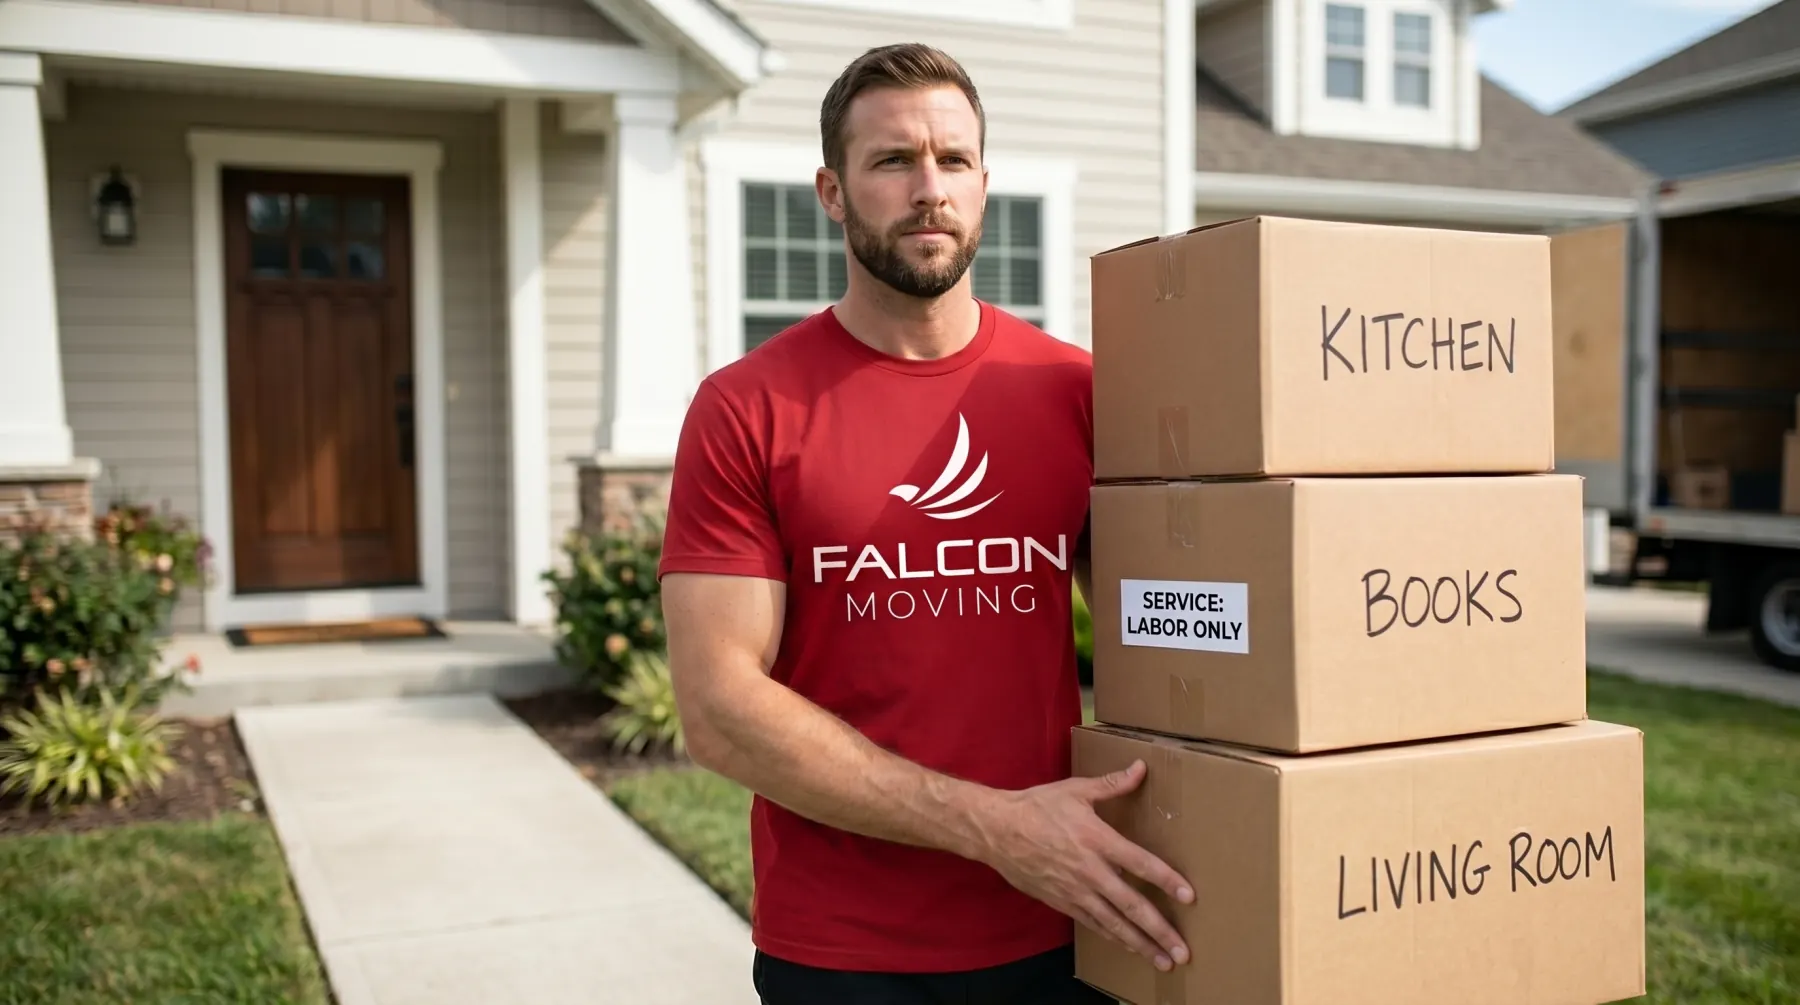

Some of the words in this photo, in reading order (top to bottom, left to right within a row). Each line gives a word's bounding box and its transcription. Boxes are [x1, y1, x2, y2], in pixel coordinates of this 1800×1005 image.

[1320, 304, 1517, 382] KITCHEN
[812, 533, 1068, 584] FALCON
[845, 584, 1037, 623] MOVING
[1142, 590, 1225, 614] SERVICE:
[1360, 568, 1524, 639] BOOKS
[1126, 616, 1189, 639] LABOR
[1193, 619, 1244, 642] ONLY
[1337, 839, 1493, 921] LIVING
[1507, 824, 1617, 893] ROOM
